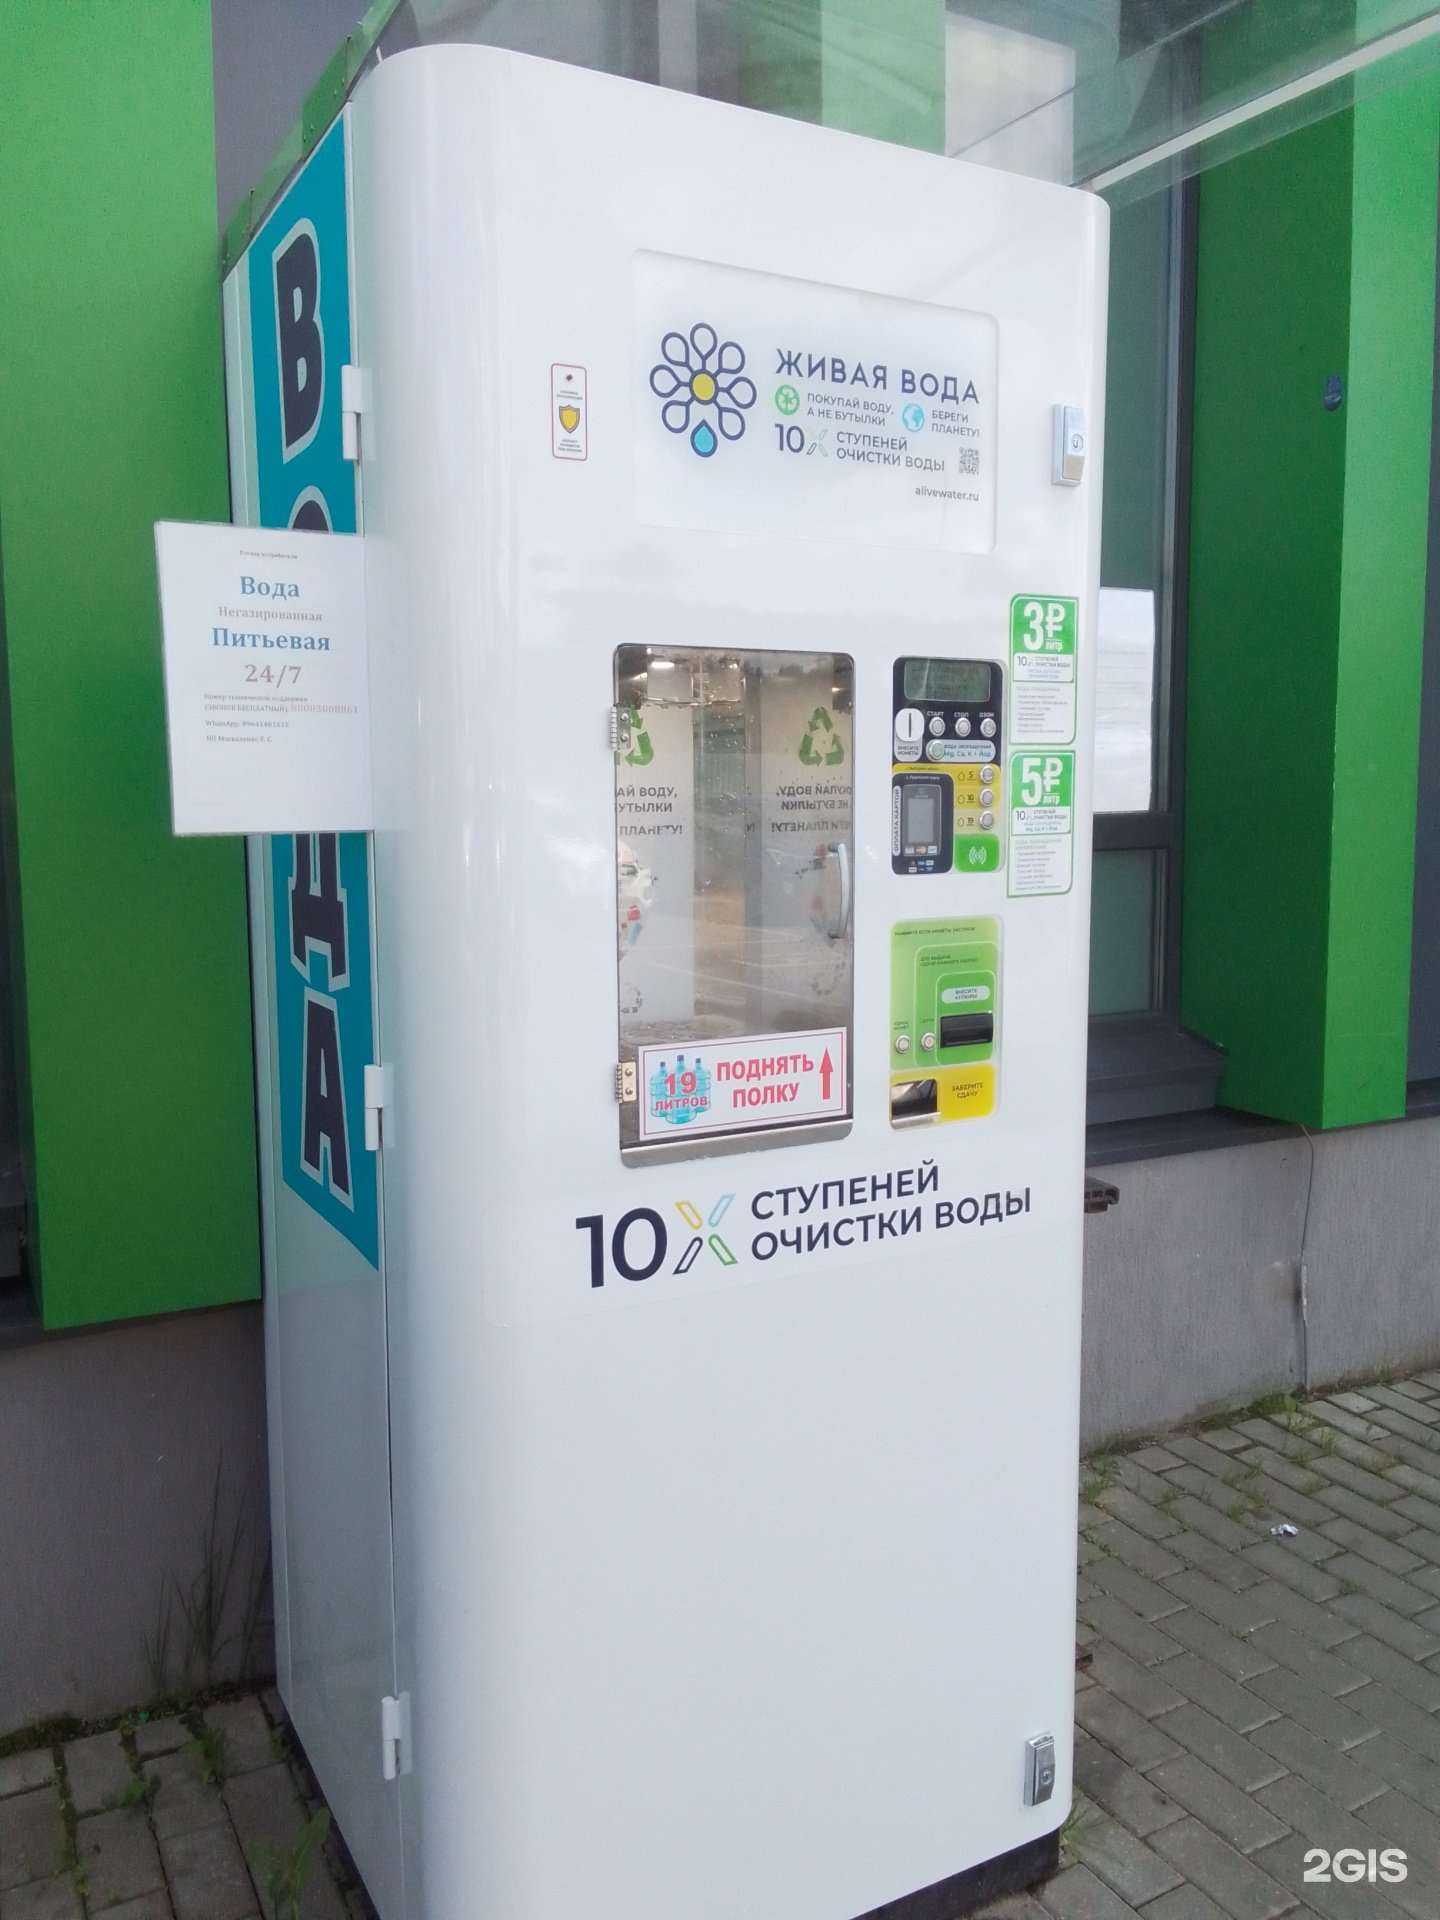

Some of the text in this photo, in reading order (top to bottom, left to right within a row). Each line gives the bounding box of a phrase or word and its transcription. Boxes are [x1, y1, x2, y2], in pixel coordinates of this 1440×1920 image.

[775, 348, 980, 405] ЖИВАЯ ВОДА
[807, 392, 895, 416] ПОКУПАЙ ВОДУ,
[807, 406, 886, 427] А НЕ БУТЫЛКИ
[931, 409, 970, 424] БЕРЕГИ
[836, 430, 908, 452] СТУПЕНЕЙ
[931, 423, 981, 438] ПЛАНЕТУ!
[836, 447, 945, 473] ОЧИСТКИ ВОДЫ
[914, 486, 980, 502] alivewater.ru
[239, 575, 300, 600] Вода
[218, 606, 323, 622] Негазированная
[212, 627, 331, 651] Питьевая
[245, 664, 302, 688] 24/7
[640, 786, 678, 798] ВОДУ,
[618, 802, 673, 813] УТЫЛКИ
[716, 1053, 815, 1082] ПОДНЯТЬ
[664, 1071, 697, 1096] 19
[732, 1082, 800, 1108] ПОЛКУ
[655, 1096, 709, 1112] ЛИТРОВ
[750, 1157, 940, 1221] СТУПЕНЕЙ
[750, 1186, 1031, 1261] ОЧИСТКИ ВОДЫ
